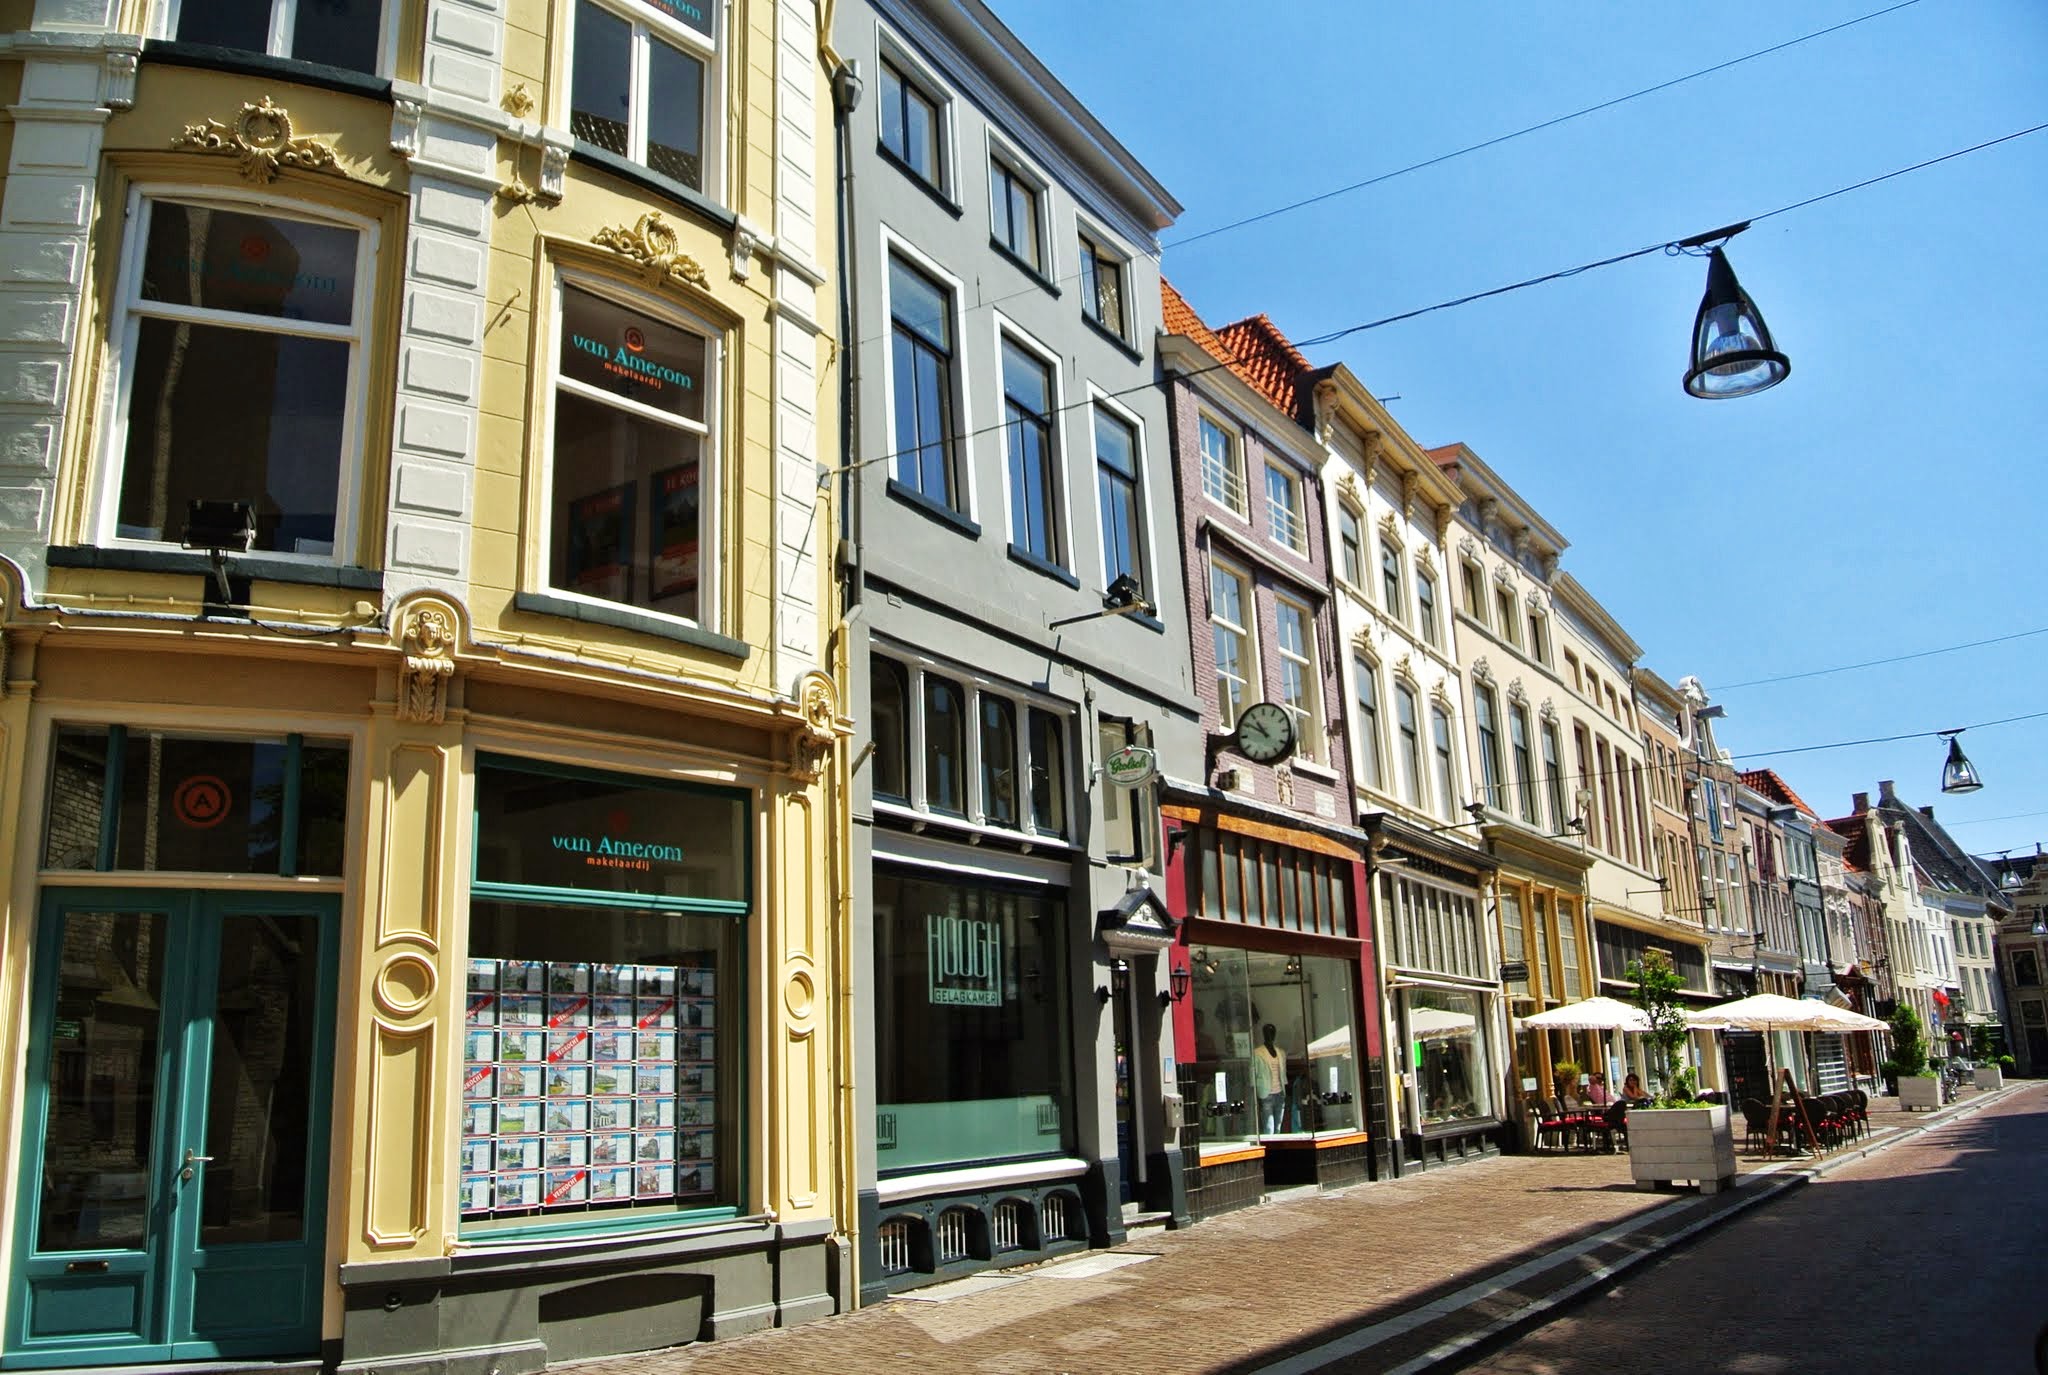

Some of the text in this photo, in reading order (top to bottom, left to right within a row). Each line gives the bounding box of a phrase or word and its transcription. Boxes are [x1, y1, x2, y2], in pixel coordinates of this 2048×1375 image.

[572, 334, 692, 389] van Amerom
[603, 362, 662, 390] makelaardij
[1109, 754, 1148, 774] Grolsch
[552, 835, 683, 862] van Amerom
[586, 856, 651, 871] makelaardij
[927, 914, 1002, 1006] HOOGH
[935, 990, 998, 1005] GELAGKAMER
[555, 1037, 579, 1057] VERKOCHT
[553, 1177, 578, 1198] VERKOCHT
